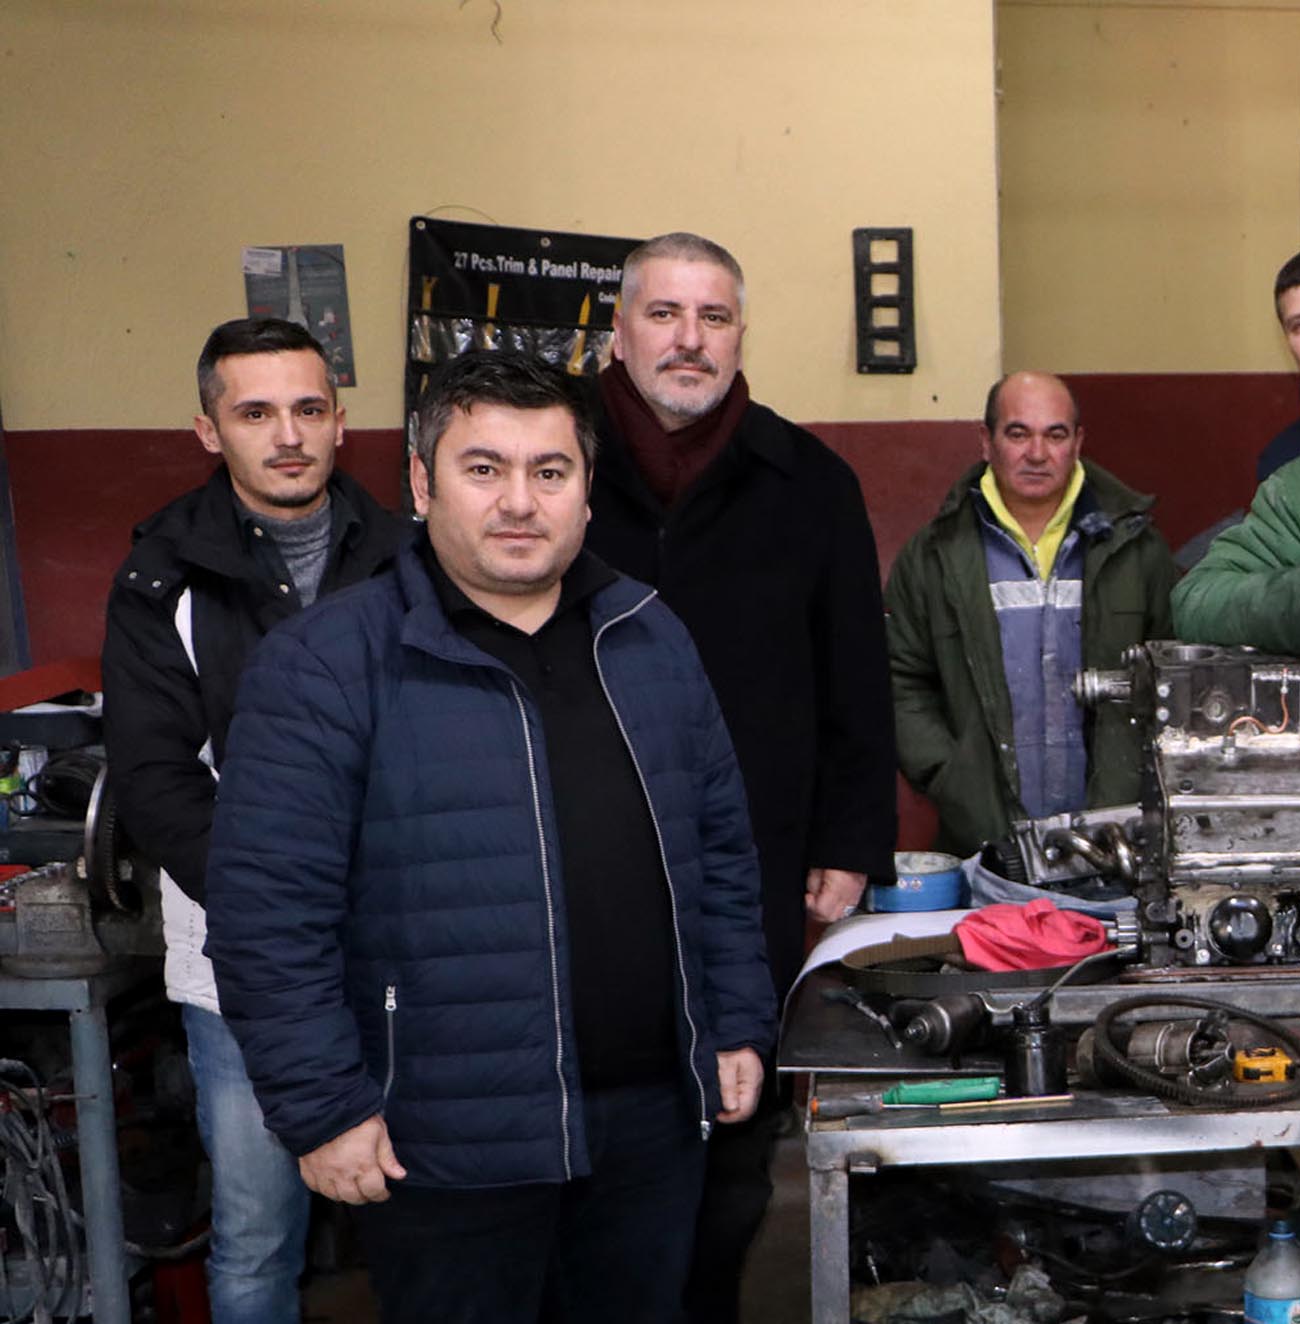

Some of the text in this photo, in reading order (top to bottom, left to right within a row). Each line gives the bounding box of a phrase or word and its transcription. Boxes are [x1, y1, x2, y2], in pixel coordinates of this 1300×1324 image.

[454, 252, 468, 269] 27
[528, 258, 538, 276] &
[541, 259, 577, 278] Panel
[580, 262, 623, 283] Repair
